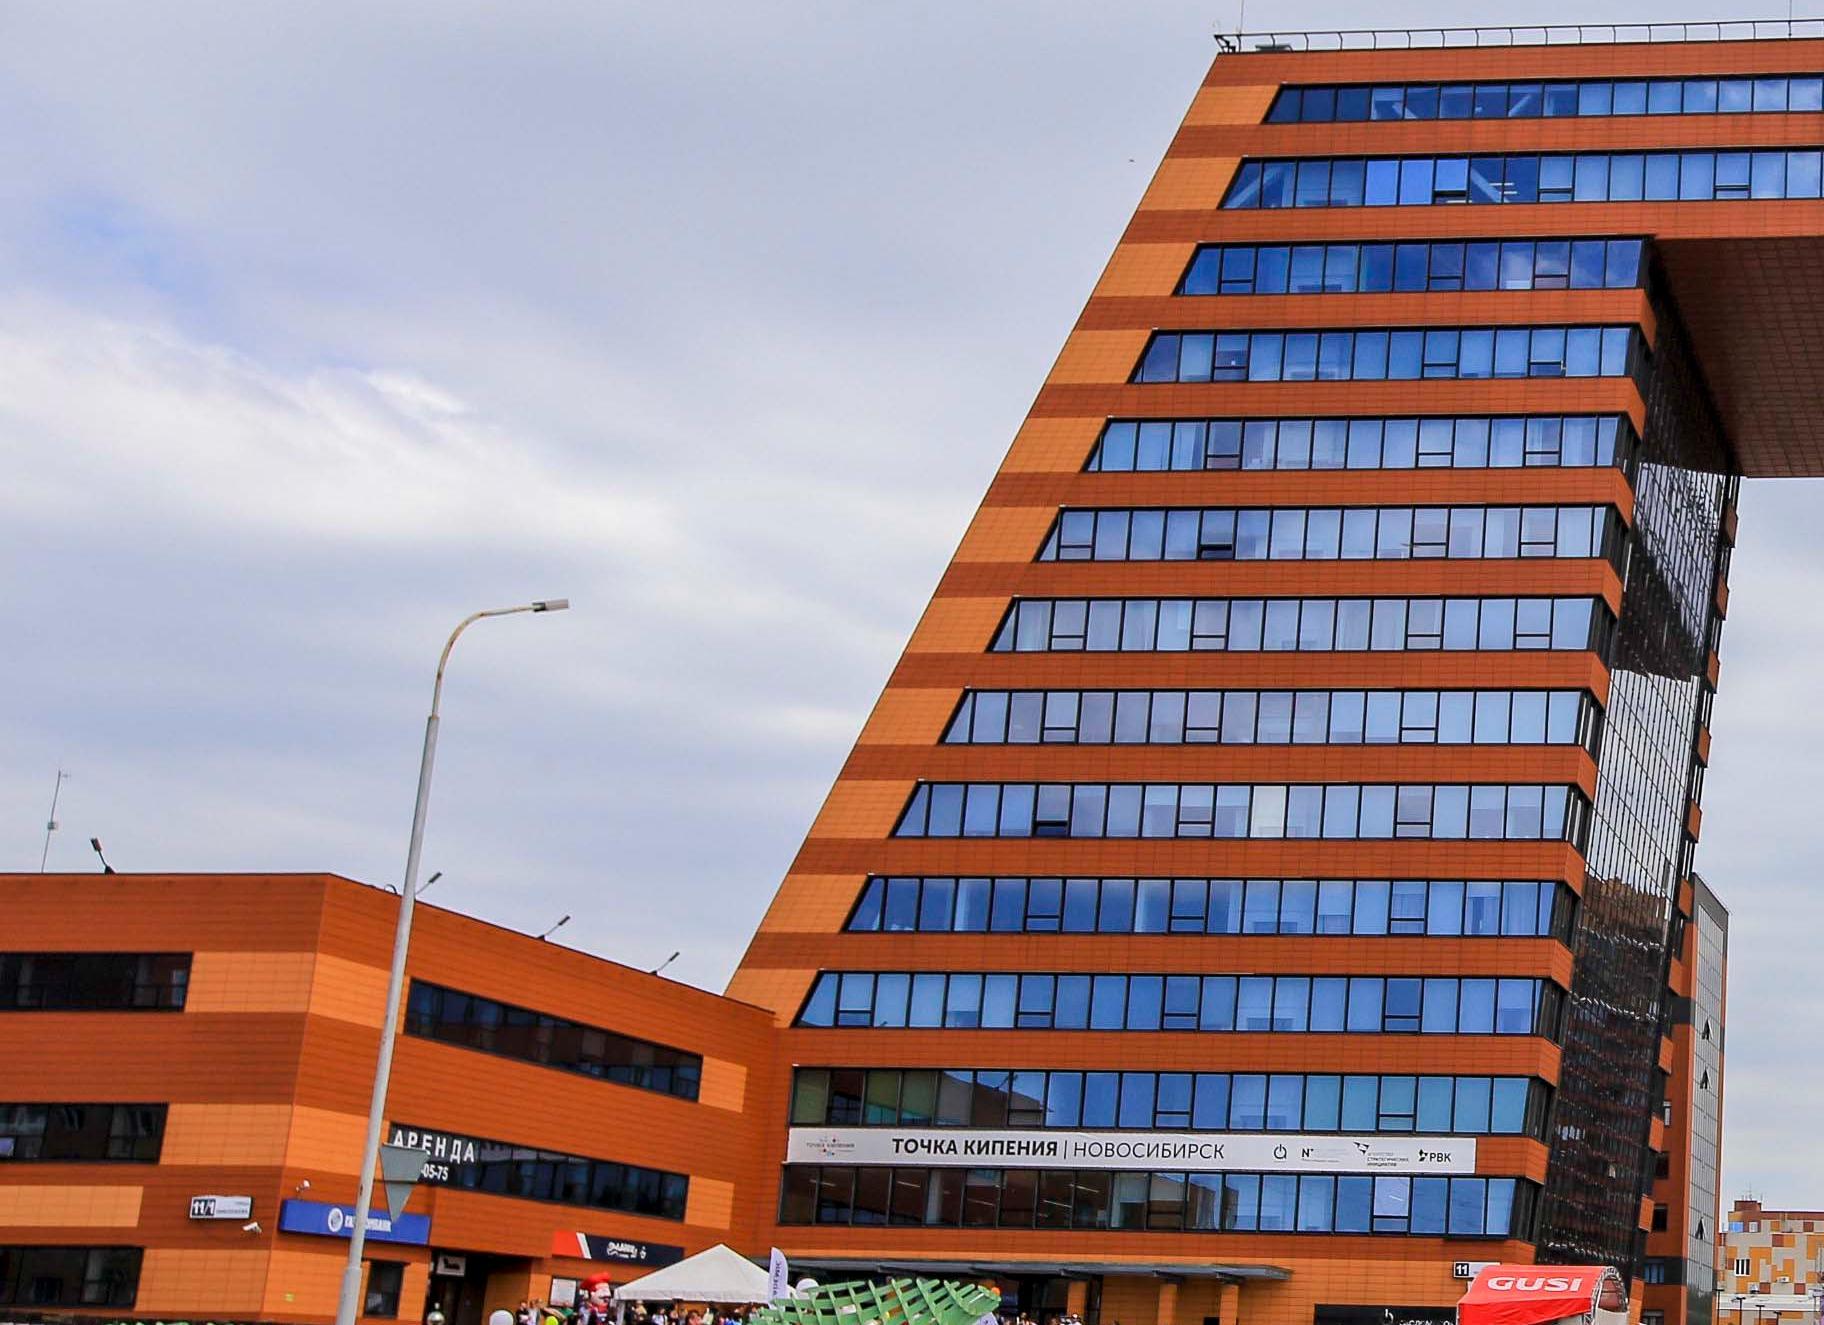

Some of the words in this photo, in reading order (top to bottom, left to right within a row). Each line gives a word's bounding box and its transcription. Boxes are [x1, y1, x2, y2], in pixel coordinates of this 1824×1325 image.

[393, 1129, 475, 1164] АРЕНДА
[892, 1138, 958, 1154] ТОЧКА
[963, 1139, 1058, 1156] КИПЕНИЯ
[1073, 1141, 1225, 1159] НОВОСИБИРСК
[1429, 1152, 1451, 1162] РВК
[193, 1201, 215, 1214] 11/1
[1456, 1265, 1468, 1275] 11
[1487, 1276, 1583, 1292] GUSI
